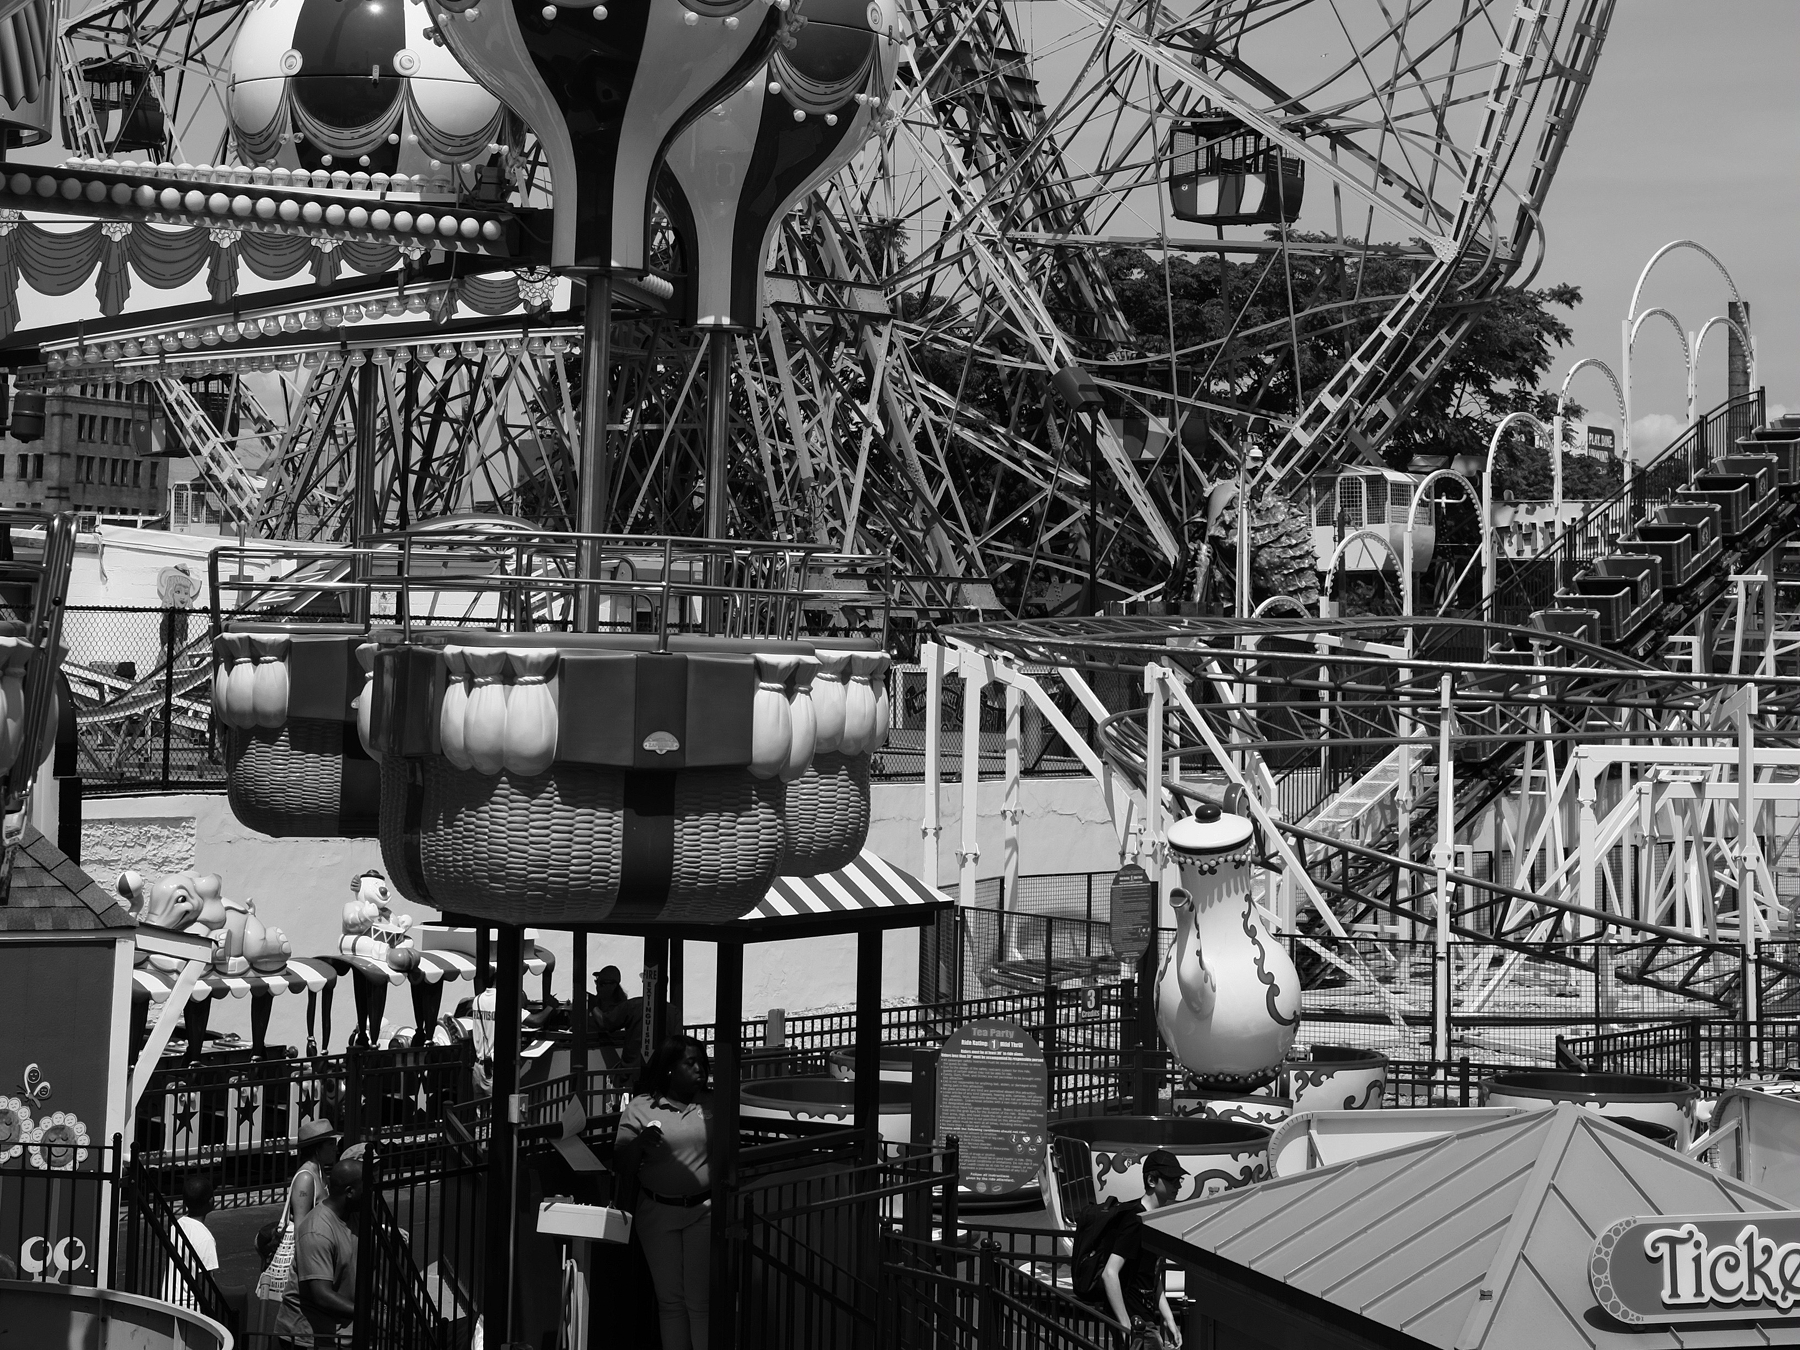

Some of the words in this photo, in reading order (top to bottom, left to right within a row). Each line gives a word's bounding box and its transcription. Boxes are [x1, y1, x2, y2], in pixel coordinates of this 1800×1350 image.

[643, 969, 657, 980] FIRE
[1087, 989, 1096, 1009] 3
[1081, 1008, 1100, 1018] Credits
[644, 981, 652, 1057] EXTINGUISHER
[971, 1028, 988, 1037] Tea
[990, 1028, 1015, 1039] Party
